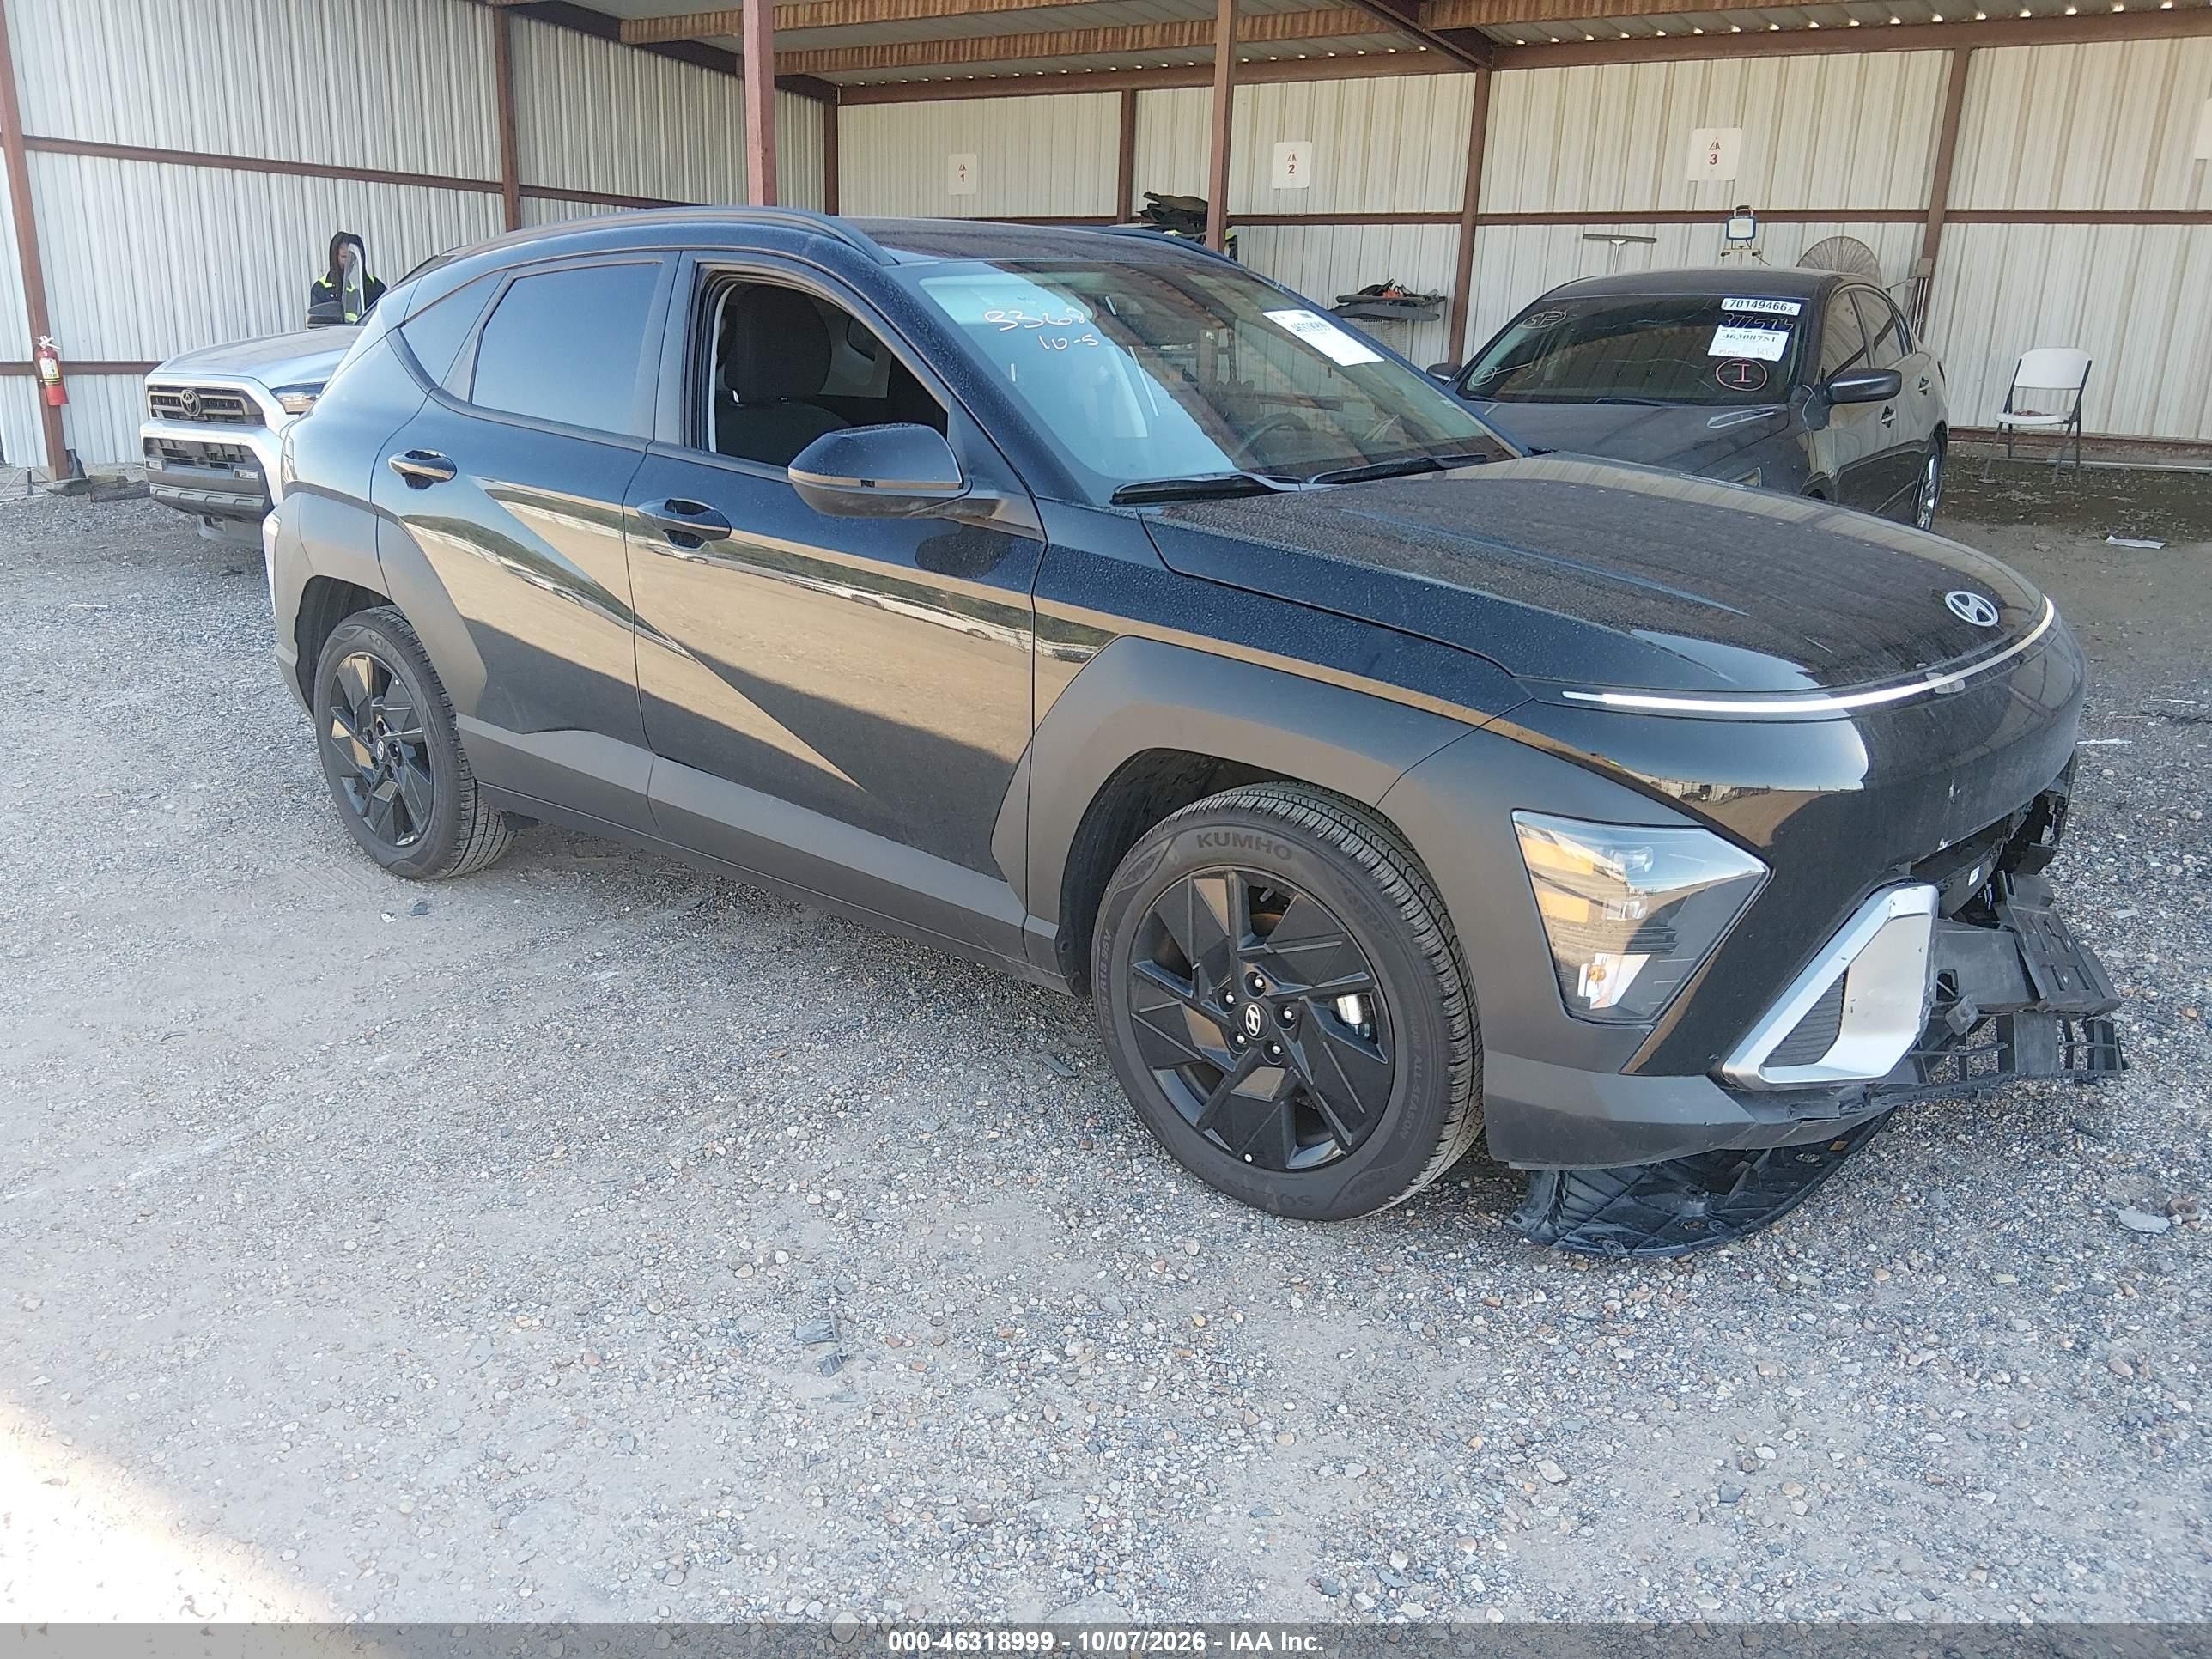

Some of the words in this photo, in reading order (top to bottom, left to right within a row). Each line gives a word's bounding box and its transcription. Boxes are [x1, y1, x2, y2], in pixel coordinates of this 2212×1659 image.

[1709, 154, 1718, 165] 3
[1287, 164, 1296, 174] 2
[960, 173, 965, 183] 1
[1196, 831, 1293, 860] KUMHO
